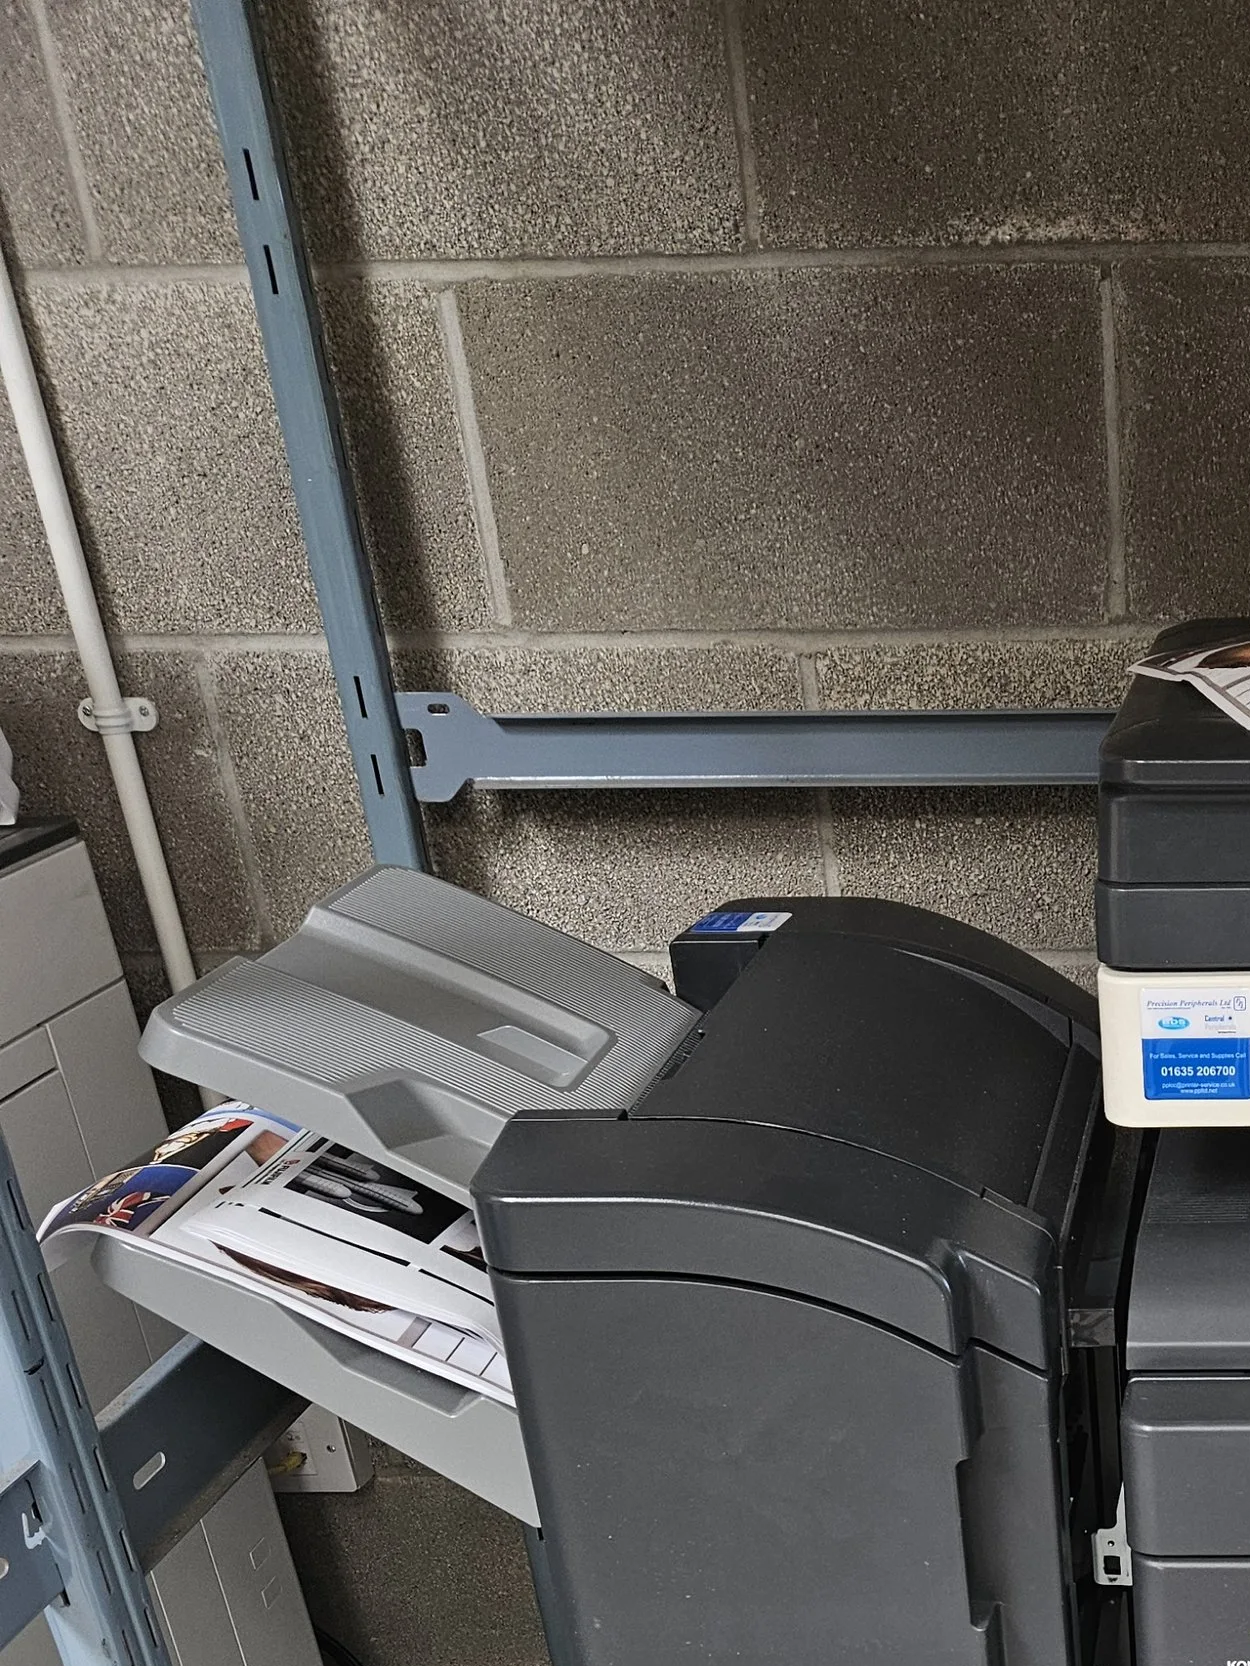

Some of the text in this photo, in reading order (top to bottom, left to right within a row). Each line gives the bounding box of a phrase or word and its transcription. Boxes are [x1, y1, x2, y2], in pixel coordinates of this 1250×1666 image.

[1180, 1000, 1218, 1008] Peripherals
[1161, 1066, 1236, 1077] 01635 206700
